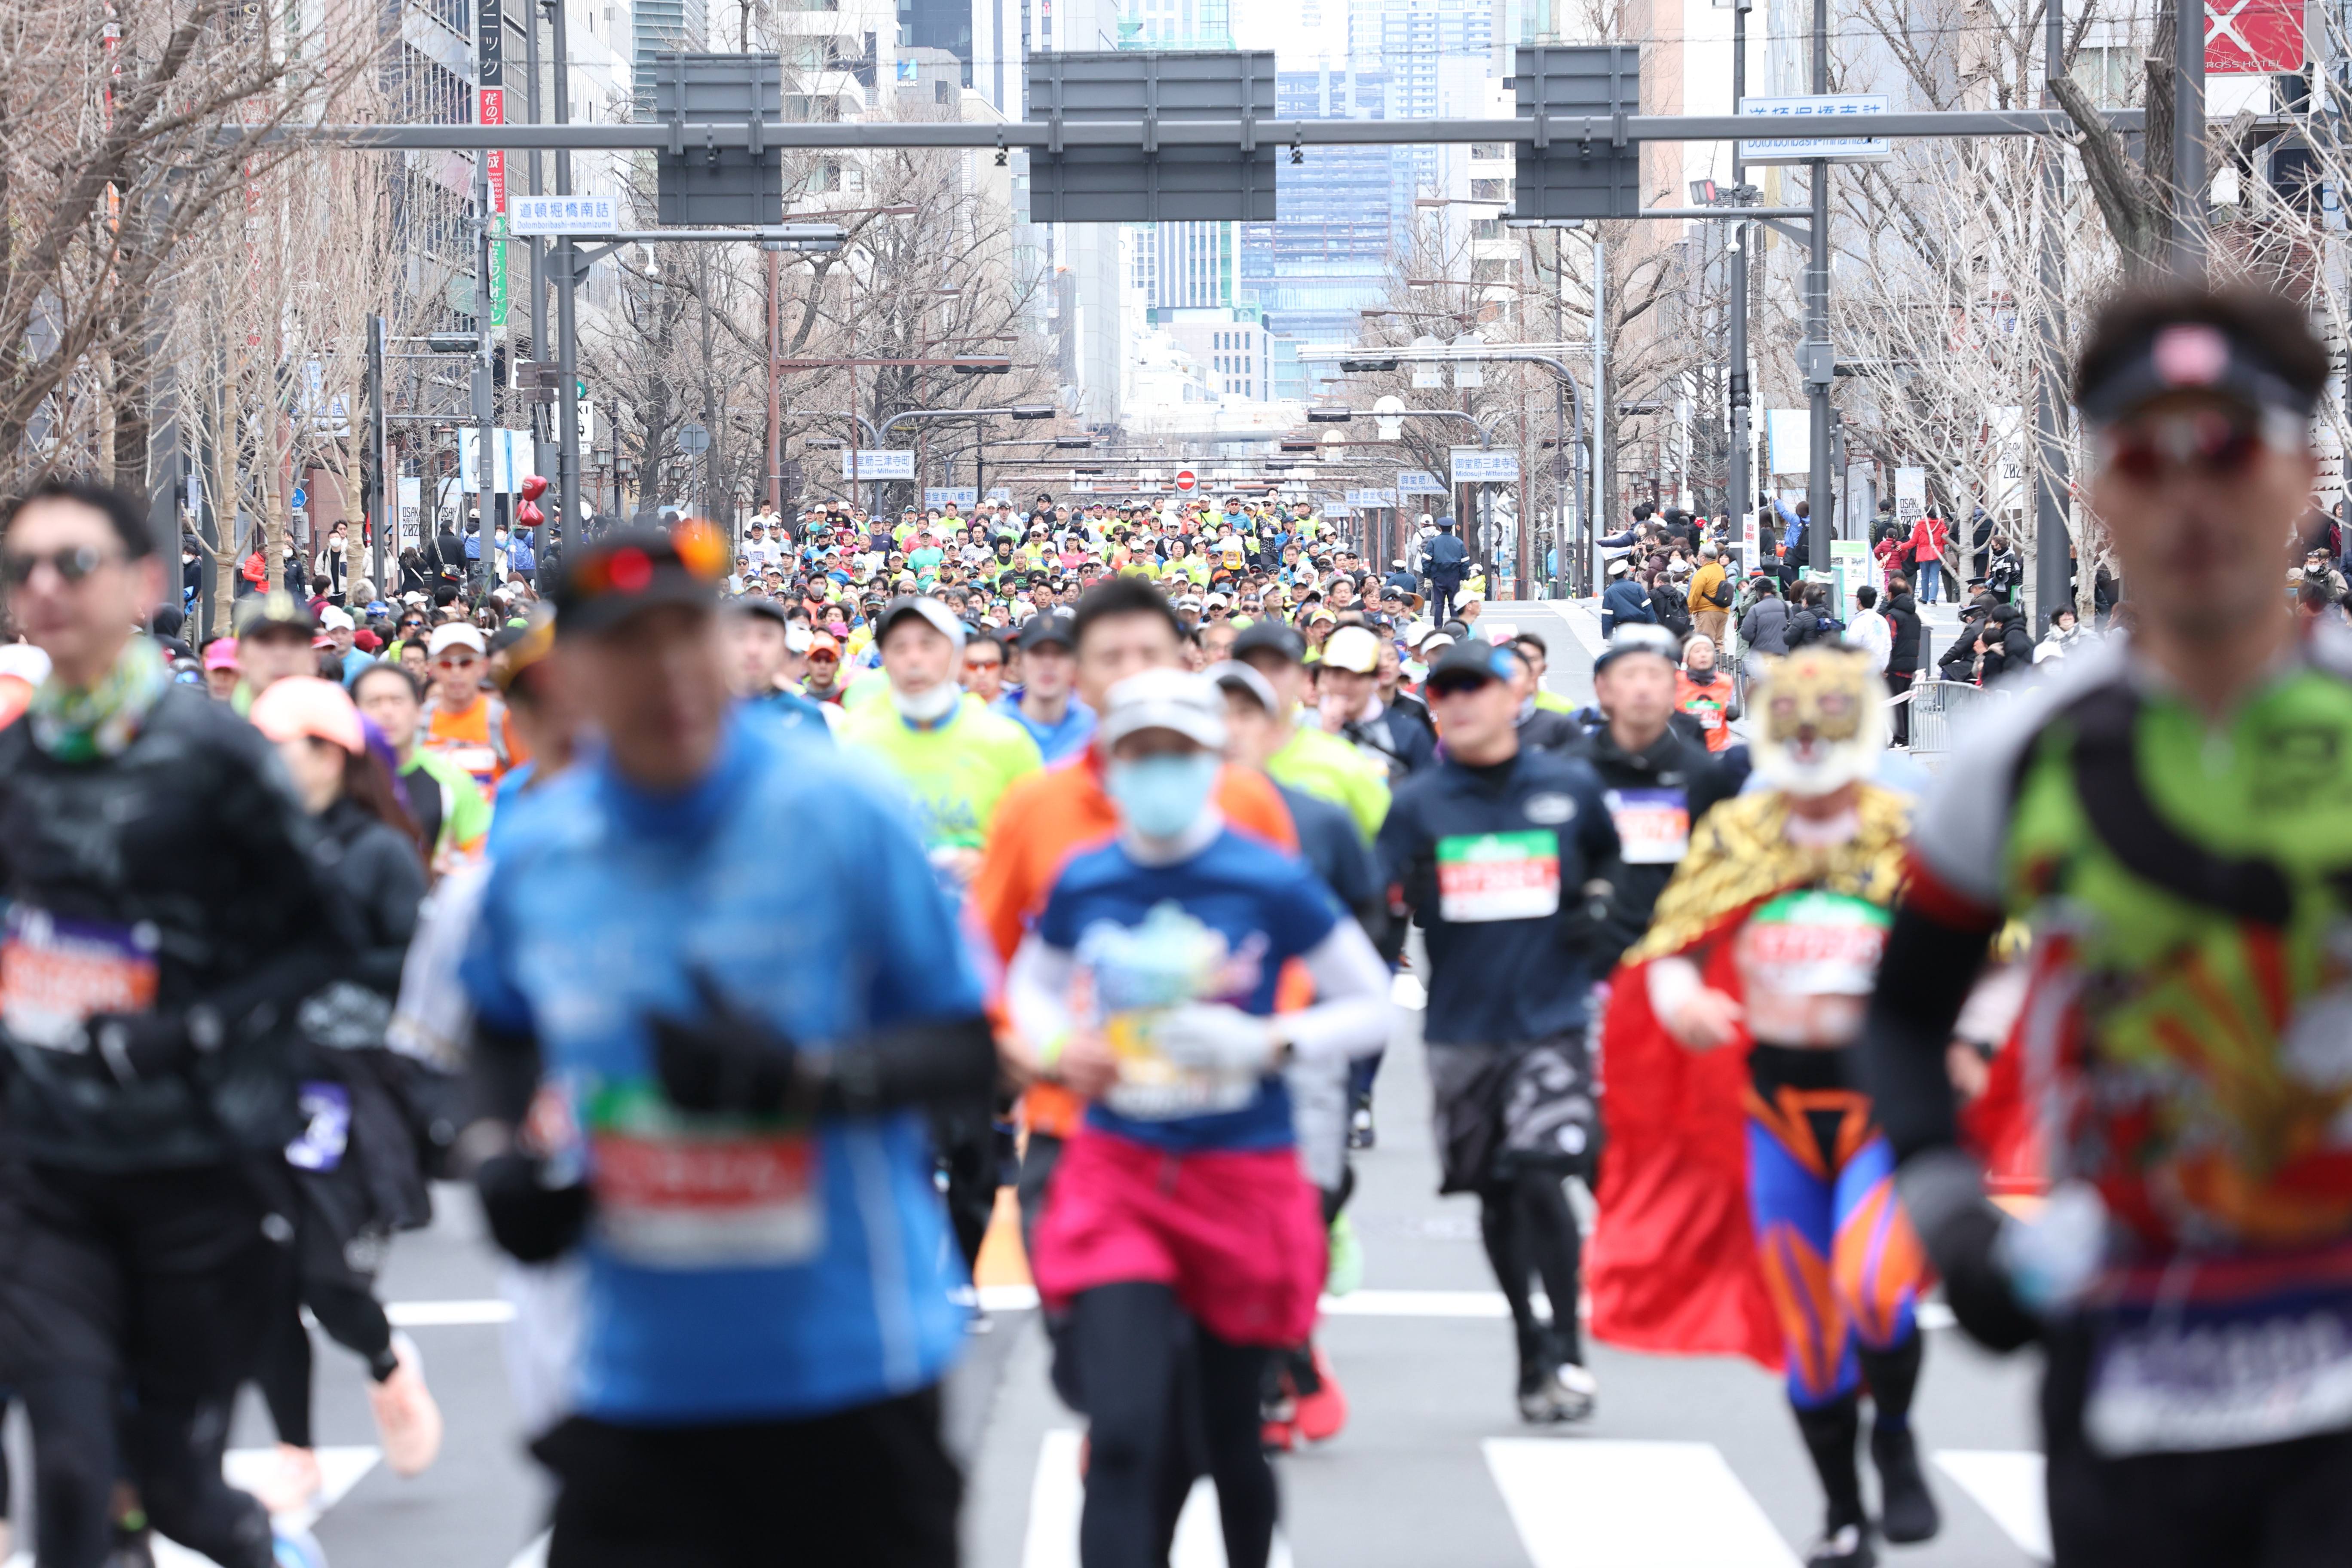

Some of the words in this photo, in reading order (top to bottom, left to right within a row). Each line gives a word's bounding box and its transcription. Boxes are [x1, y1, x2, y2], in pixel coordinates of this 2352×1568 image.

[520, 202, 609, 218] 道頓堀橋南詰
[578, 406, 588, 414] XI
[1900, 499, 1919, 508] OSAK
[402, 507, 420, 517] OSAK
[403, 524, 420, 536] 202
